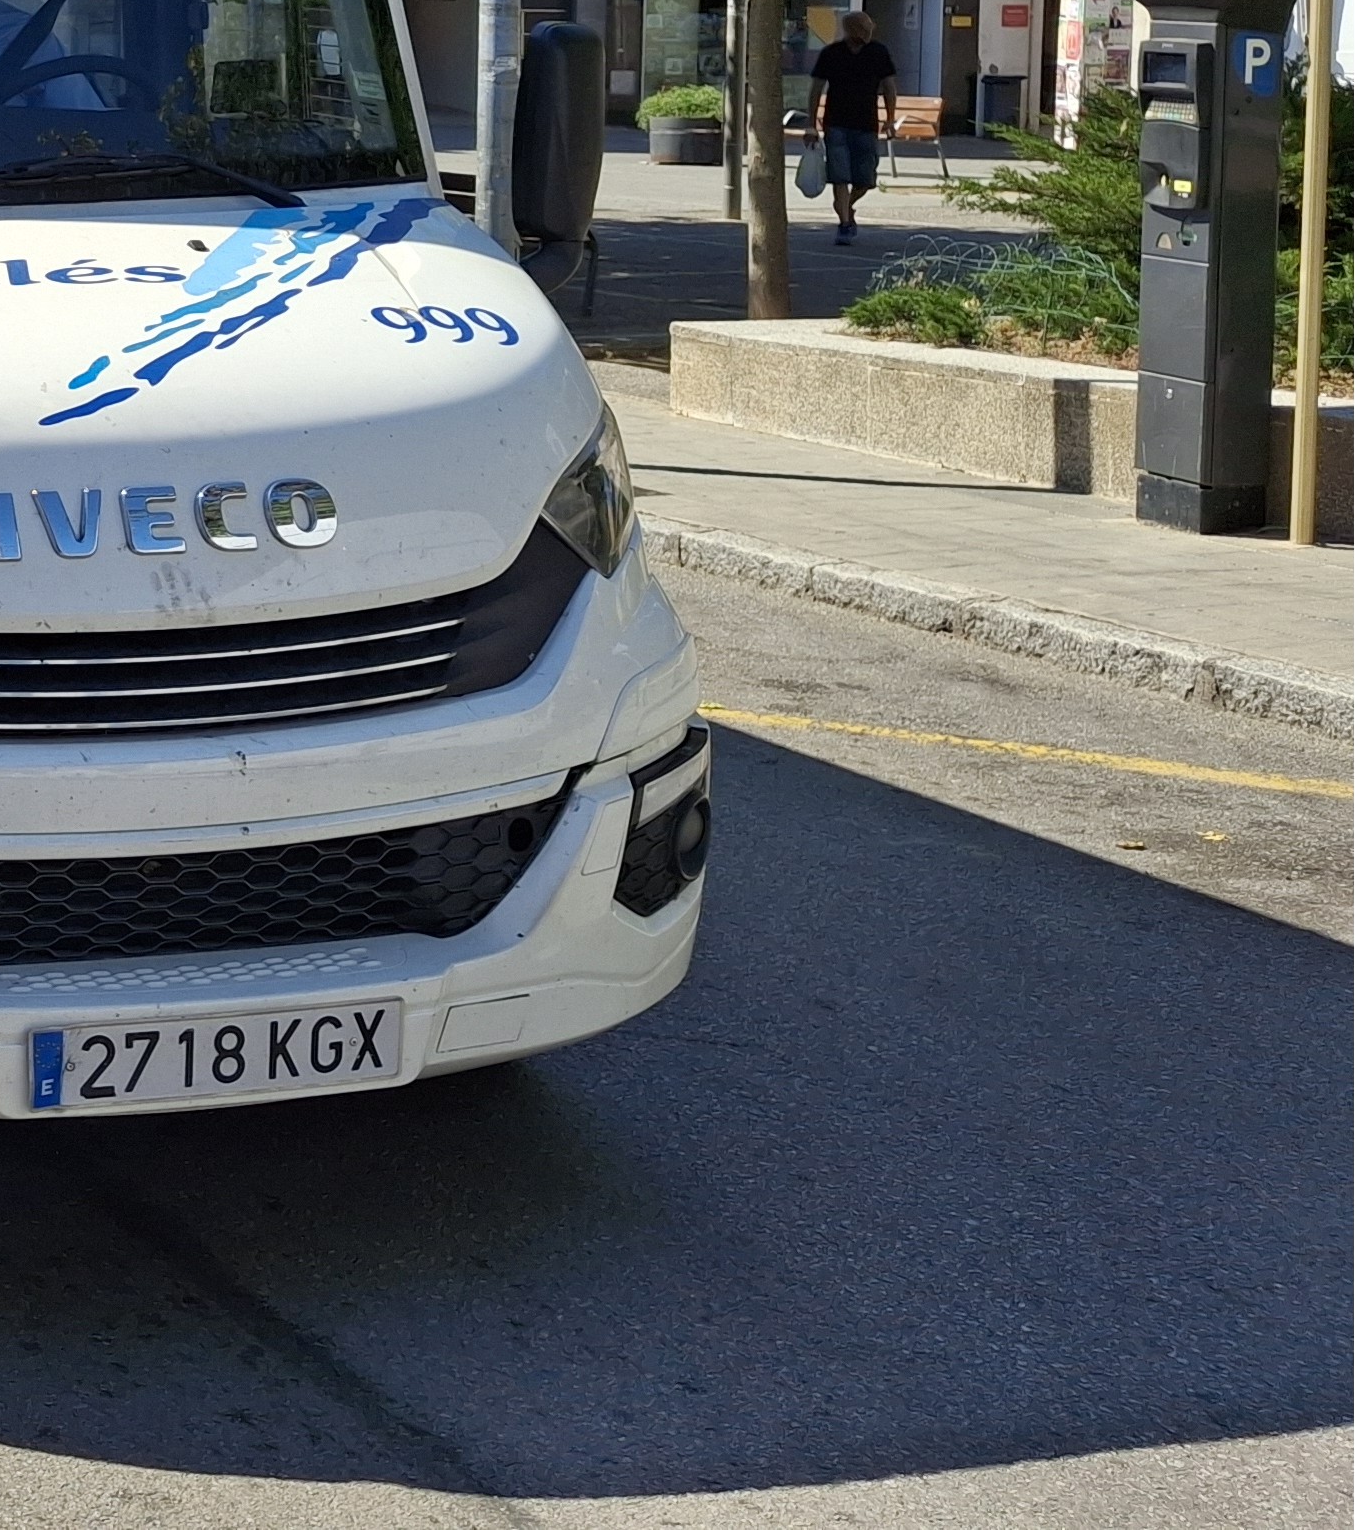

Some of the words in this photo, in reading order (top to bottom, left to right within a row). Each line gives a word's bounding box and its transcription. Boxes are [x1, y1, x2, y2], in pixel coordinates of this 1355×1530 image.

[1244, 38, 1271, 85] P
[369, 305, 520, 346] 999
[79, 1024, 246, 1099] 2718
[268, 1009, 386, 1080] KGX
[40, 1078, 55, 1096] E
